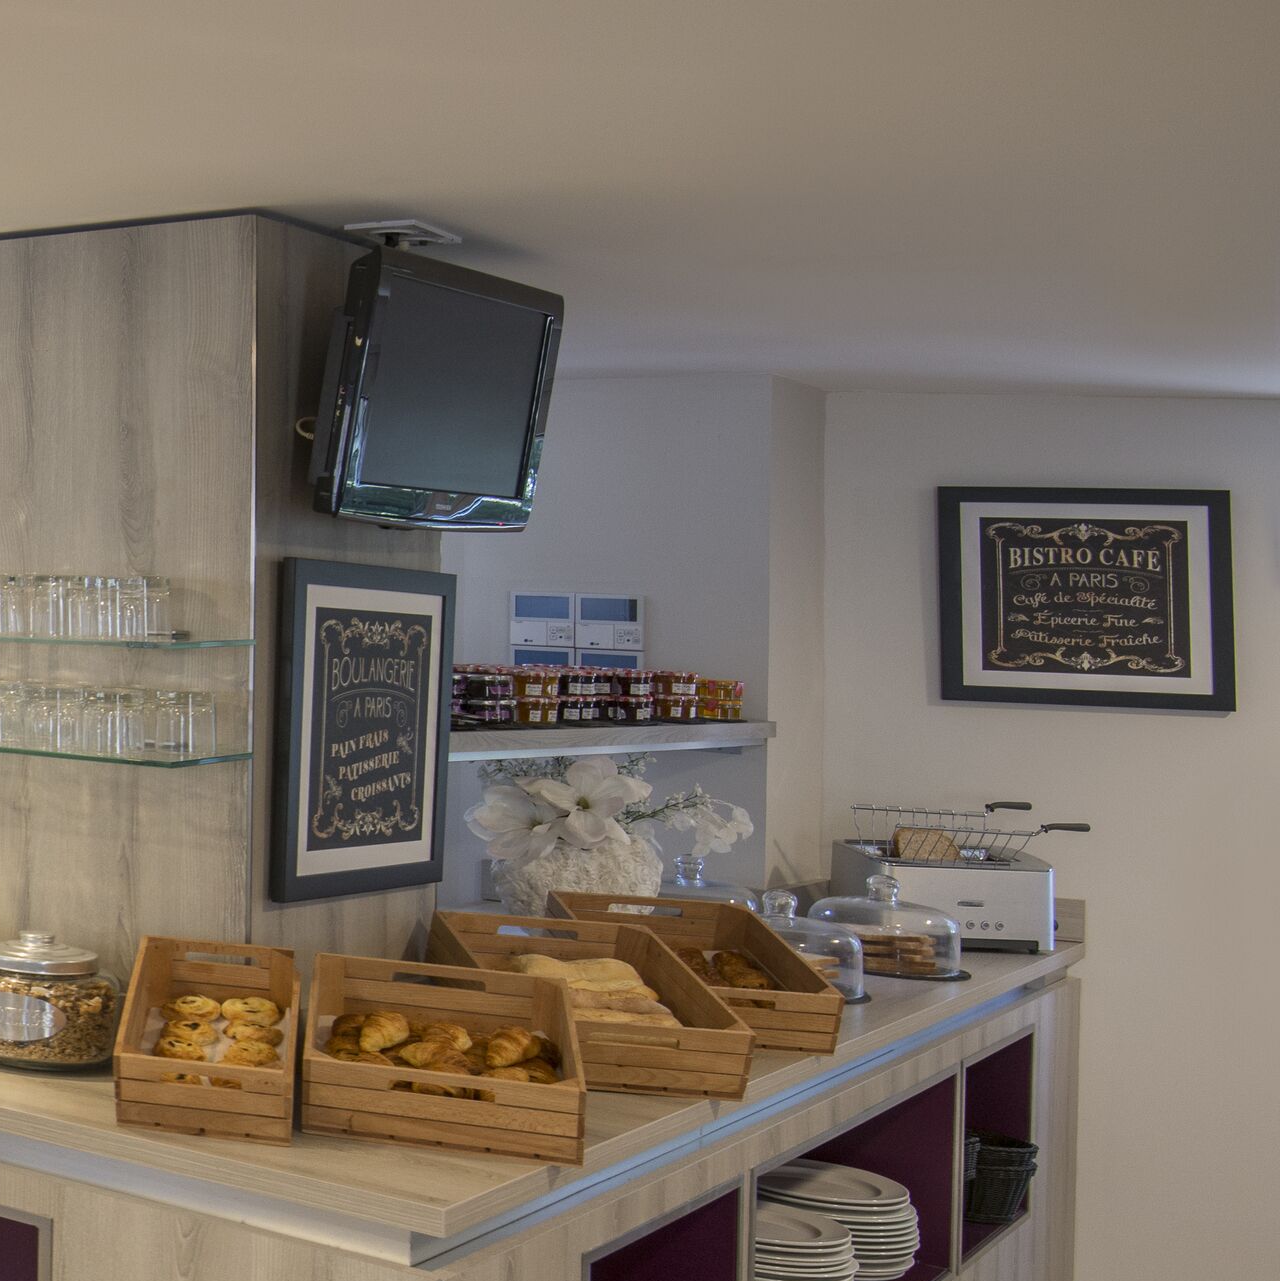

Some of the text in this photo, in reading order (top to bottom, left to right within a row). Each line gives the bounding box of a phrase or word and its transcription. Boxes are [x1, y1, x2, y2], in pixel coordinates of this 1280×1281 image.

[1008, 547, 1162, 572] BISTRO CAFÉ
[1049, 572, 1119, 588] A PARIS
[1013, 592, 1051, 608] Café
[1053, 591, 1075, 603] de
[1032, 609, 1140, 628] Épicerie Fine
[1010, 628, 1096, 647] Pâtisserie
[331, 656, 416, 693] BOULANGERIE
[353, 696, 392, 718] A PARIS
[331, 728, 390, 758] PAIN FRAIS
[338, 750, 400, 781] PATISSERIE
[351, 771, 412, 802] CROISSANTS
